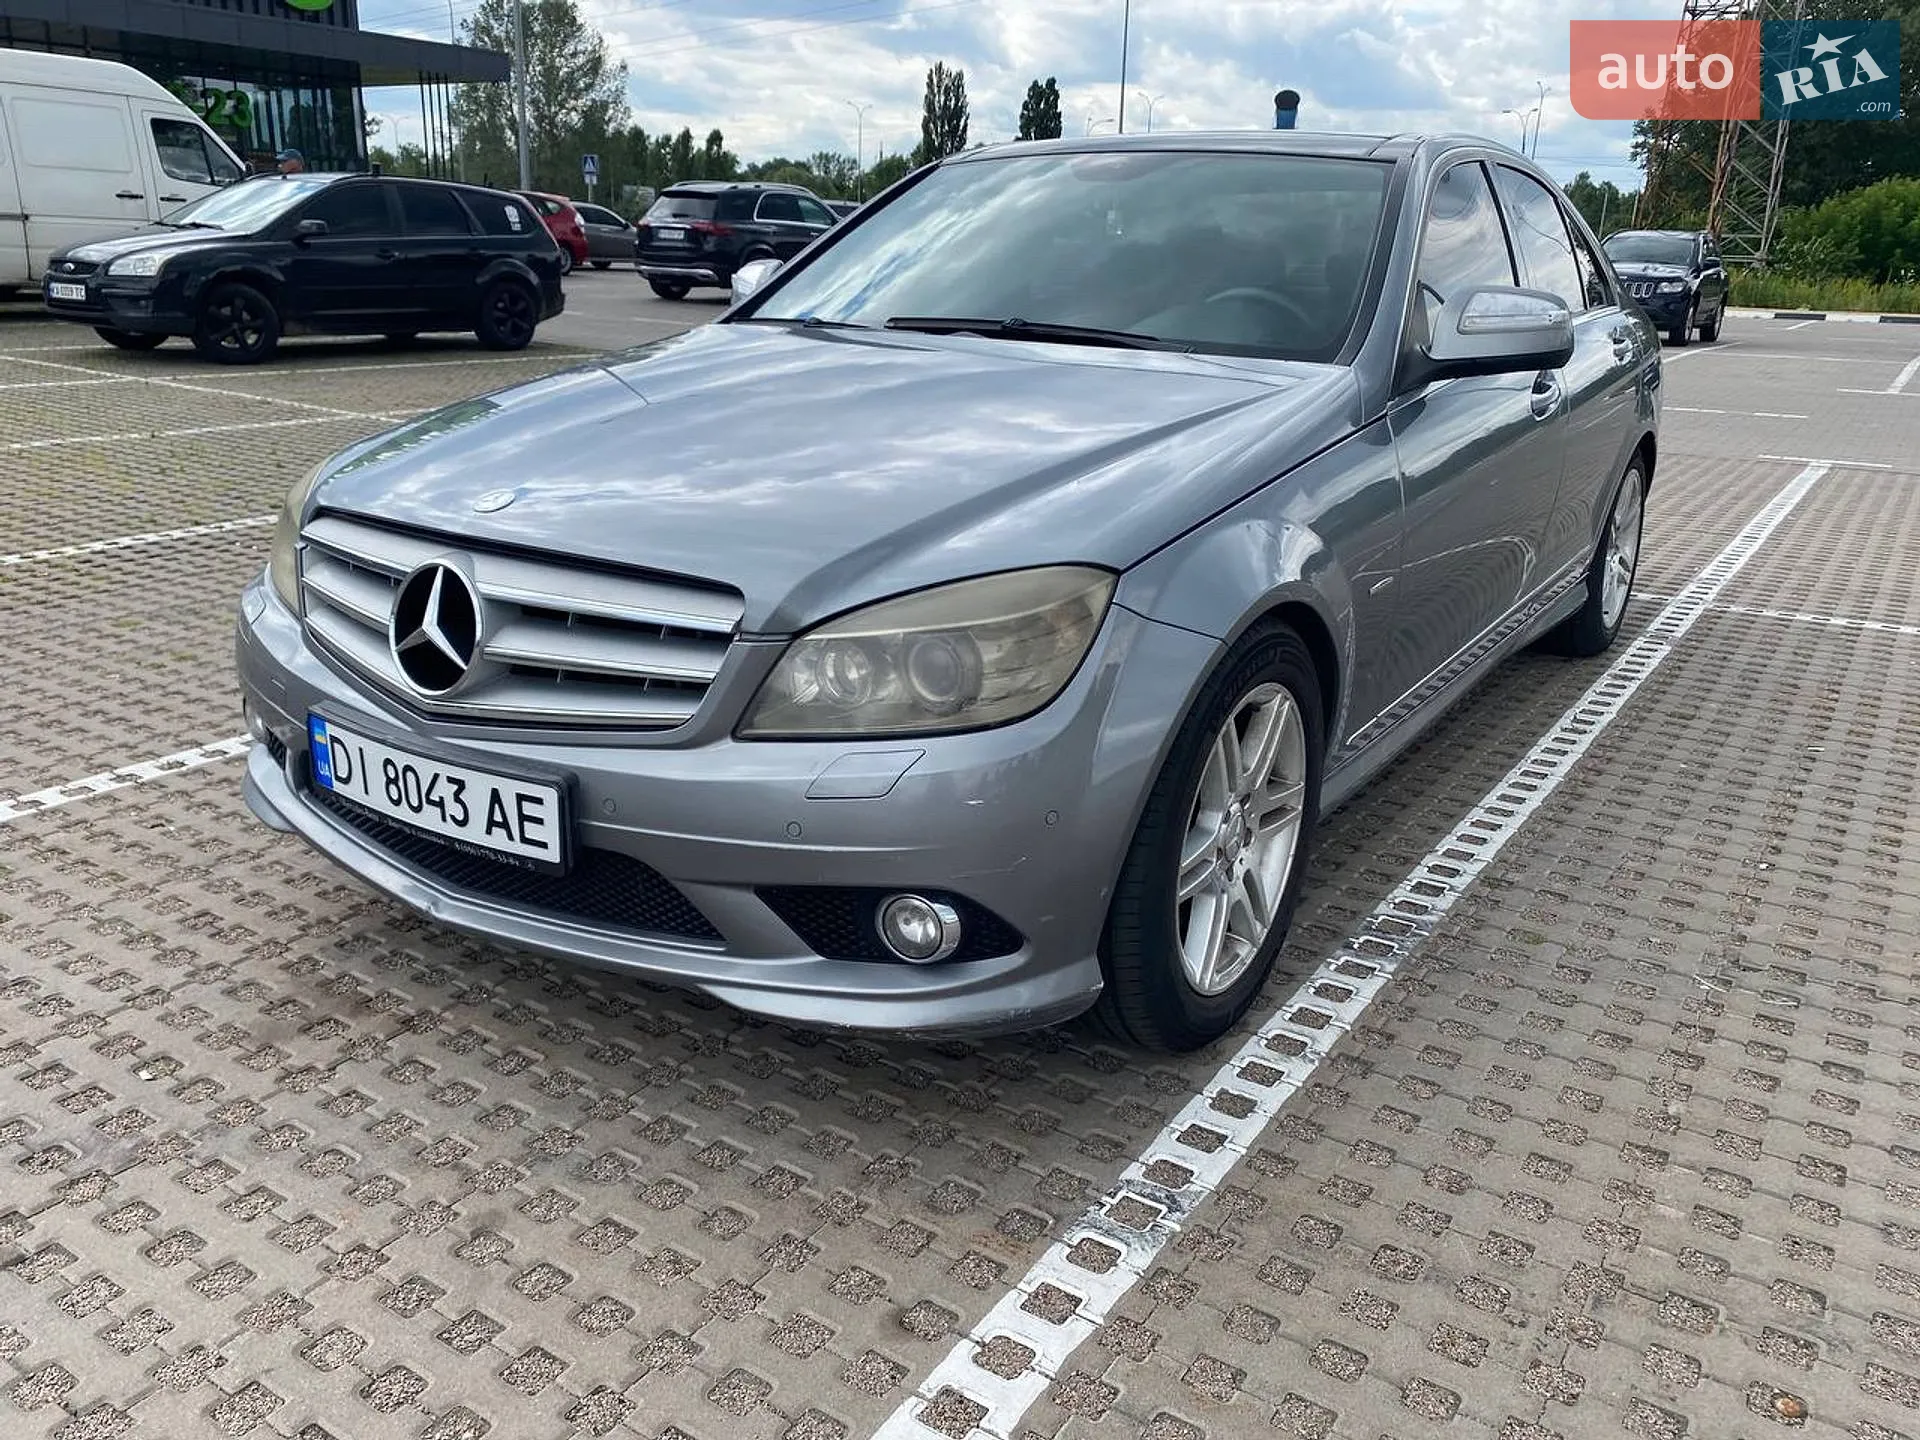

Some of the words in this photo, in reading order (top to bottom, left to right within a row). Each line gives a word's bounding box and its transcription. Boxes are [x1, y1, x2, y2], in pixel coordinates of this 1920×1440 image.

[317, 759, 332, 779] UA
[329, 733, 369, 795] DI
[383, 757, 470, 828] 8043
[485, 787, 549, 850] AE
